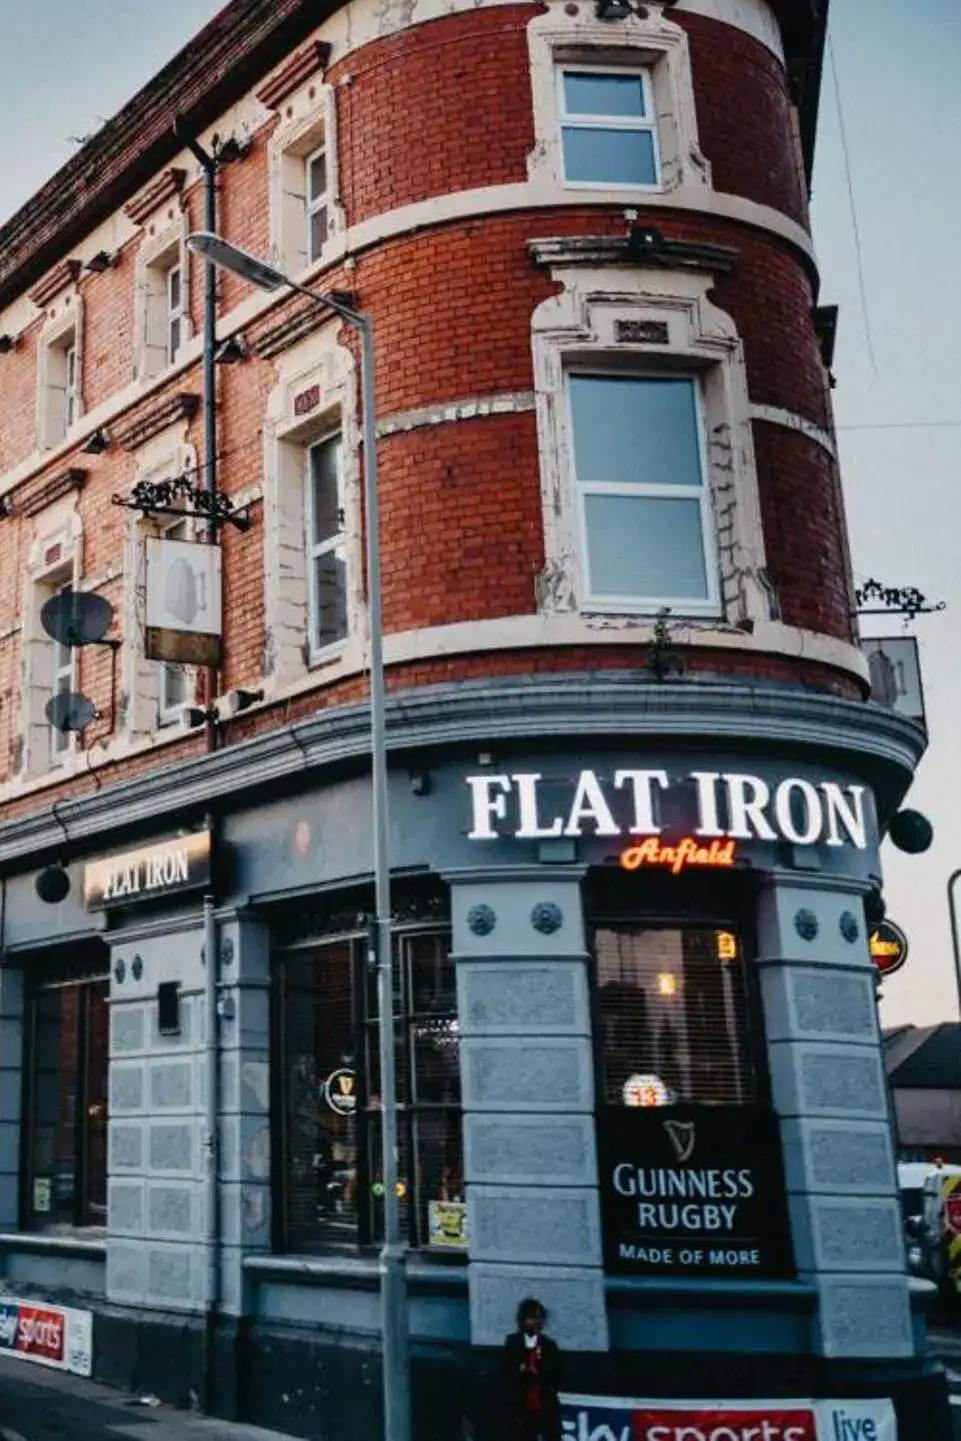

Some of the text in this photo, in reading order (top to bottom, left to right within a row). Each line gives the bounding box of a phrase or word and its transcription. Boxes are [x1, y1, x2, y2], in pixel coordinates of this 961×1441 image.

[465, 769, 870, 850] FLAT IRON
[144, 847, 189, 890] IRON
[619, 835, 737, 874] Anfield
[638, 1202, 737, 1230] RUGBY
[619, 1243, 760, 1265] MADE OF MORE
[832, 1410, 878, 1441] live
